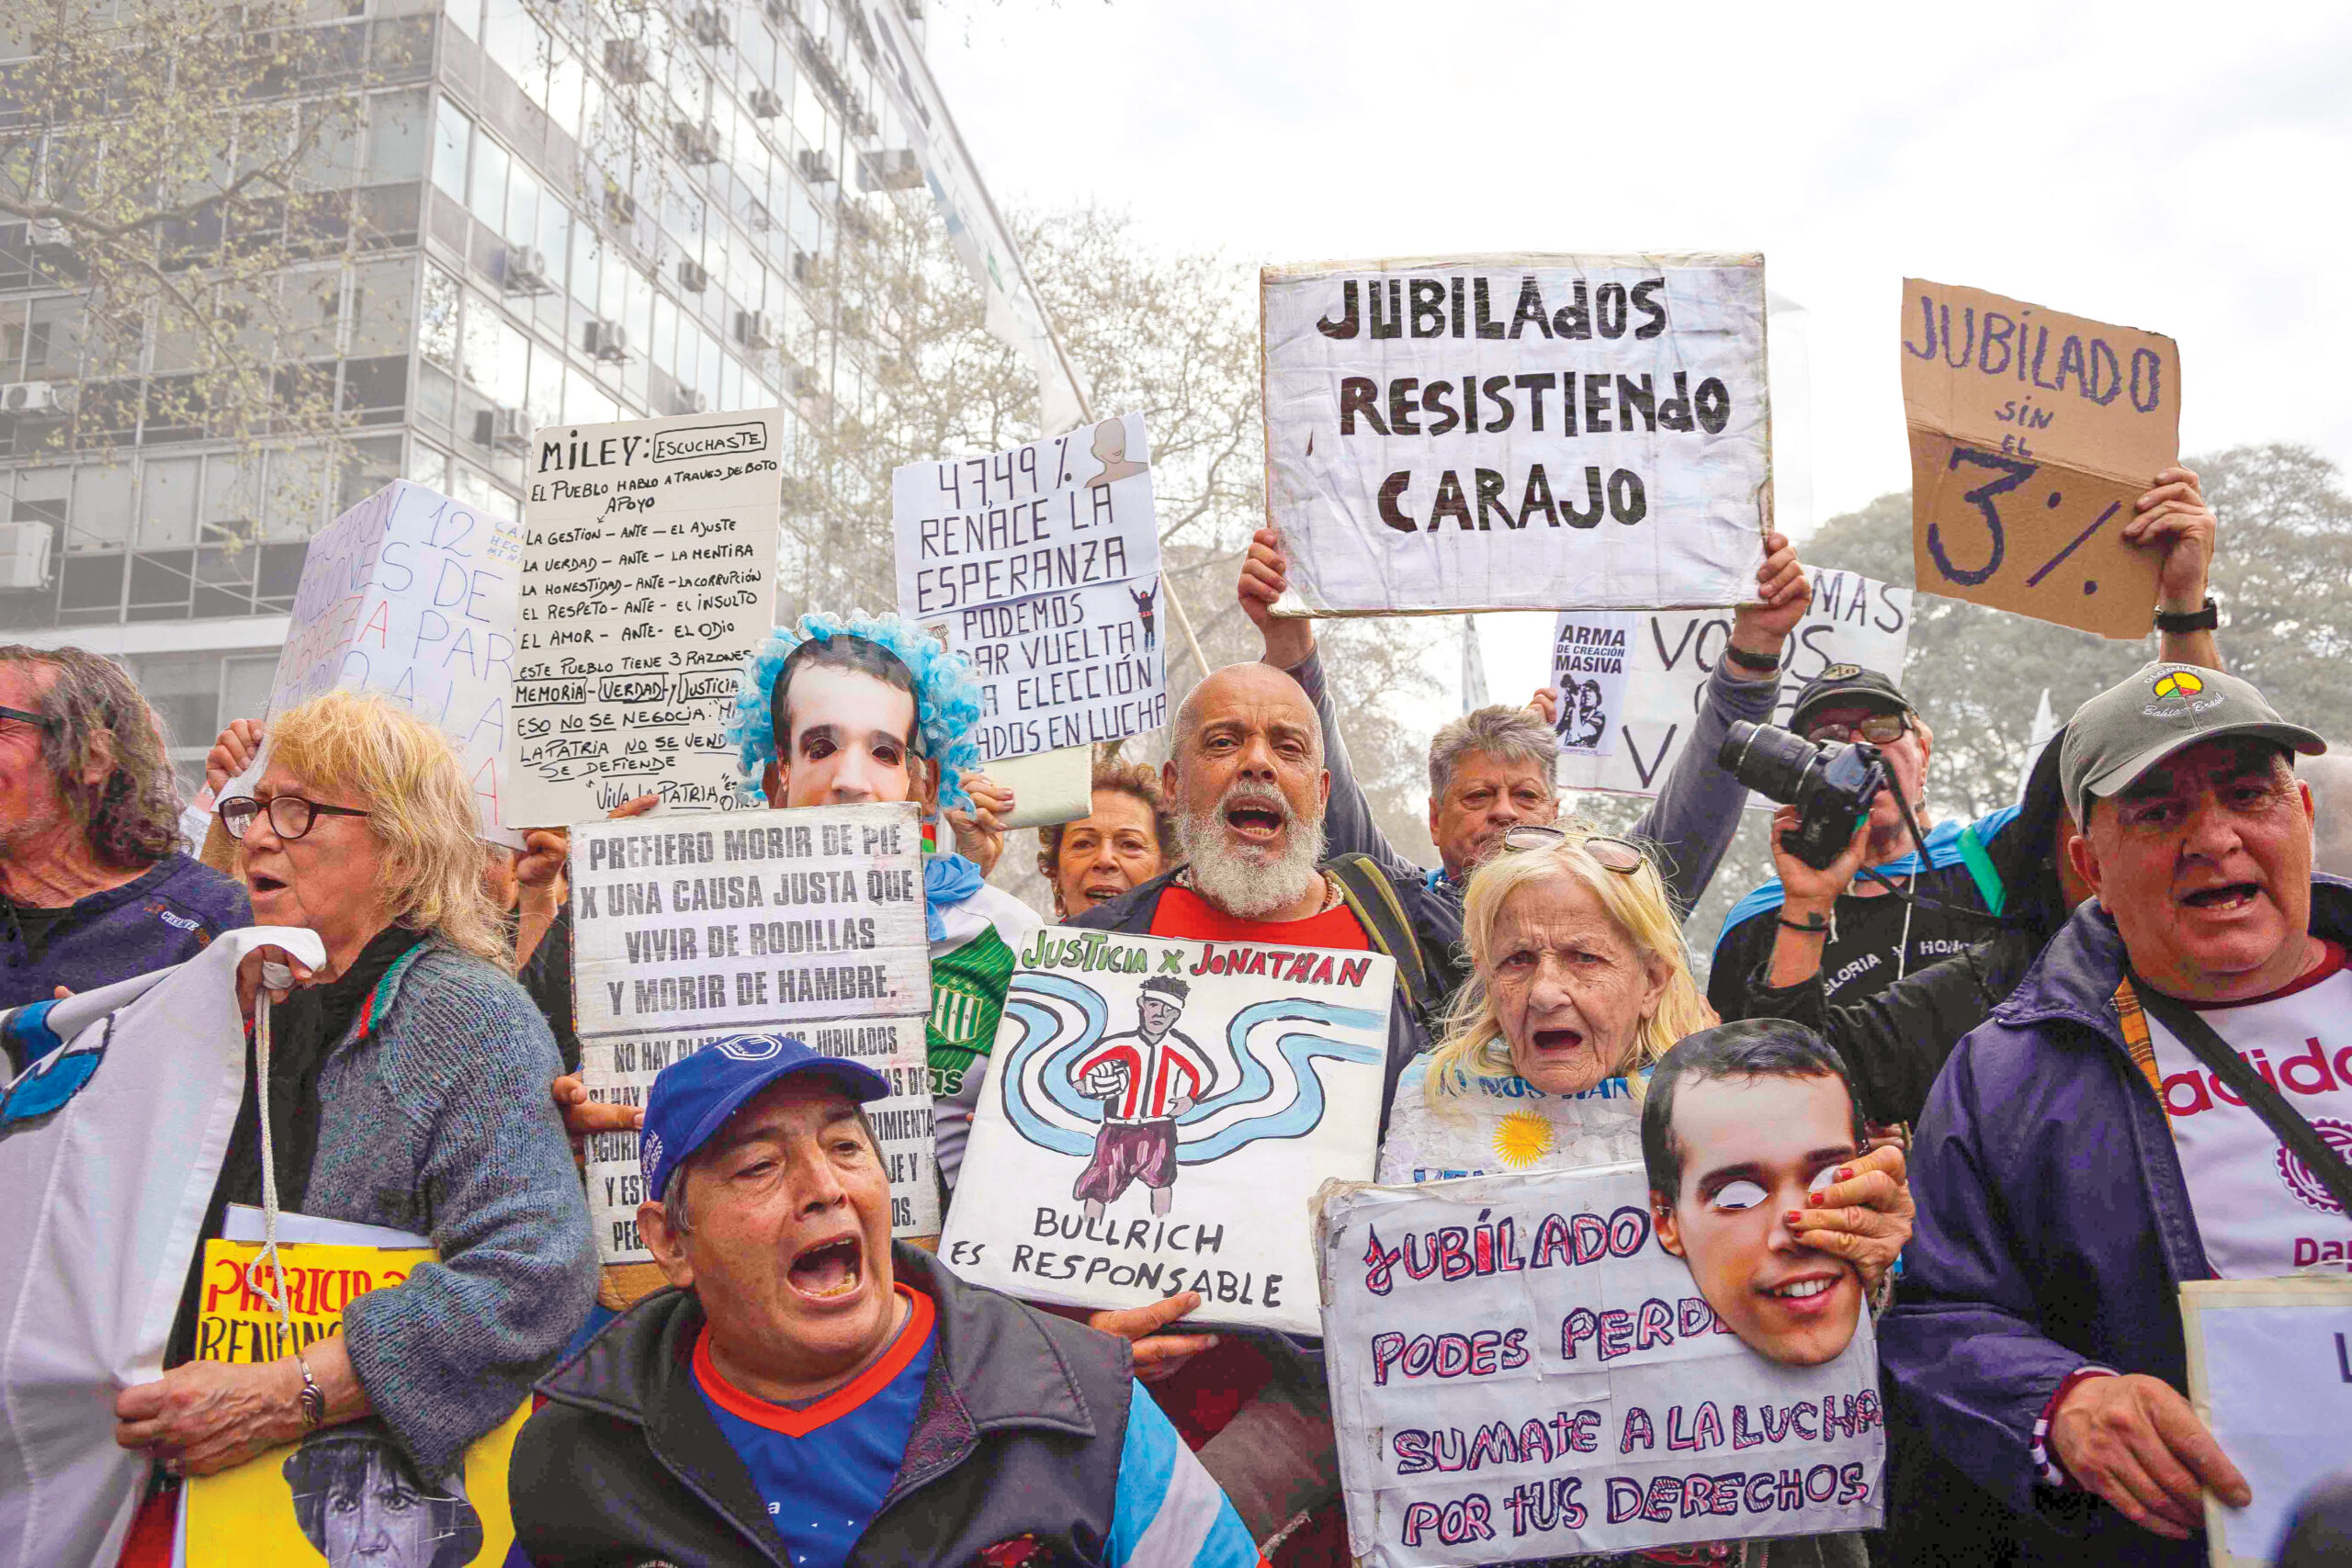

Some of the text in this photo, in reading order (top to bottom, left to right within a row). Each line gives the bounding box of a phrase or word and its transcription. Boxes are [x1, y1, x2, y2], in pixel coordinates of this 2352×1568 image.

[657, 432, 761, 458] ESCUCHASTE
[2001, 434, 2033, 457] EL
[531, 484, 547, 502] EL
[551, 481, 608, 500] PUEBLO
[616, 478, 659, 491] HABLO
[665, 473, 672, 485] A
[746, 460, 777, 471] BOTO
[1377, 464, 1647, 534] CARAJO
[605, 497, 655, 513] APOYO
[922, 483, 1113, 559] RENACE LA
[422, 502, 475, 558] 12
[526, 530, 542, 546] LA
[620, 524, 647, 537] ANTE
[671, 525, 684, 535] EL
[690, 519, 737, 536] AJUSTE
[524, 559, 537, 572] LA
[545, 558, 597, 572] VERDAD
[619, 550, 650, 565] ANTE
[672, 548, 687, 561] LA
[918, 536, 1126, 613] ESPERANZA
[434, 558, 503, 623] DE
[522, 584, 537, 596] LA
[636, 575, 664, 590] ANTE
[523, 608, 538, 620] EL
[625, 597, 654, 615] ANTE
[676, 600, 691, 611] EL
[521, 633, 540, 649] EL
[550, 629, 594, 646] AMOR
[674, 625, 694, 637] EL
[964, 592, 1084, 640] PODEMOS
[1559, 625, 1625, 647] ARMA
[413, 610, 514, 688] PAR
[520, 663, 550, 679] ESTE
[560, 658, 613, 673] PUEBLO
[669, 653, 682, 666] 3
[976, 621, 1135, 675] AR VUELTA
[1555, 655, 1622, 673] MASIVA
[1556, 645, 1624, 657] DE CREACIÓN
[1018, 654, 1152, 710] ELECCIÓN
[518, 718, 551, 735] ESO
[560, 716, 582, 730] NO
[589, 715, 614, 727] SE
[1049, 713, 1080, 749] EN
[1089, 693, 1166, 742] LUCHA
[521, 747, 542, 762] LA
[626, 739, 647, 754] NO
[655, 736, 679, 748] SE
[684, 734, 727, 750] VEND
[537, 761, 569, 778] SE
[658, 781, 718, 804] PATRIA
[590, 824, 901, 871] PREFIERO MORIR DE PIE
[580, 870, 914, 919] X UNA CAUSA JUSTA QUE
[626, 918, 875, 964] VIVIR DE RODILLAS
[1023, 930, 1148, 974] JUSTICIA
[1190, 944, 1373, 987] JONATHAN
[607, 964, 897, 1016] Y MORIR DE HAMBRE.
[615, 1043, 636, 1073] NO
[642, 1040, 671, 1071] HAY
[816, 1026, 898, 1056] JUBILADOS
[605, 1178, 615, 1207] Y
[909, 1153, 918, 1181] Y
[1035, 1208, 1224, 1255] BULLRICH
[950, 1241, 1283, 1308] ES RESPONSABLE
[1372, 1328, 1528, 1386] PODES
[1621, 1408, 1653, 1452] A
[1668, 1402, 1724, 1451] LA
[1733, 1389, 1883, 1449] LUCHA
[1403, 1499, 1495, 1548] POR
[1607, 1462, 1869, 1523] DERECHOS
